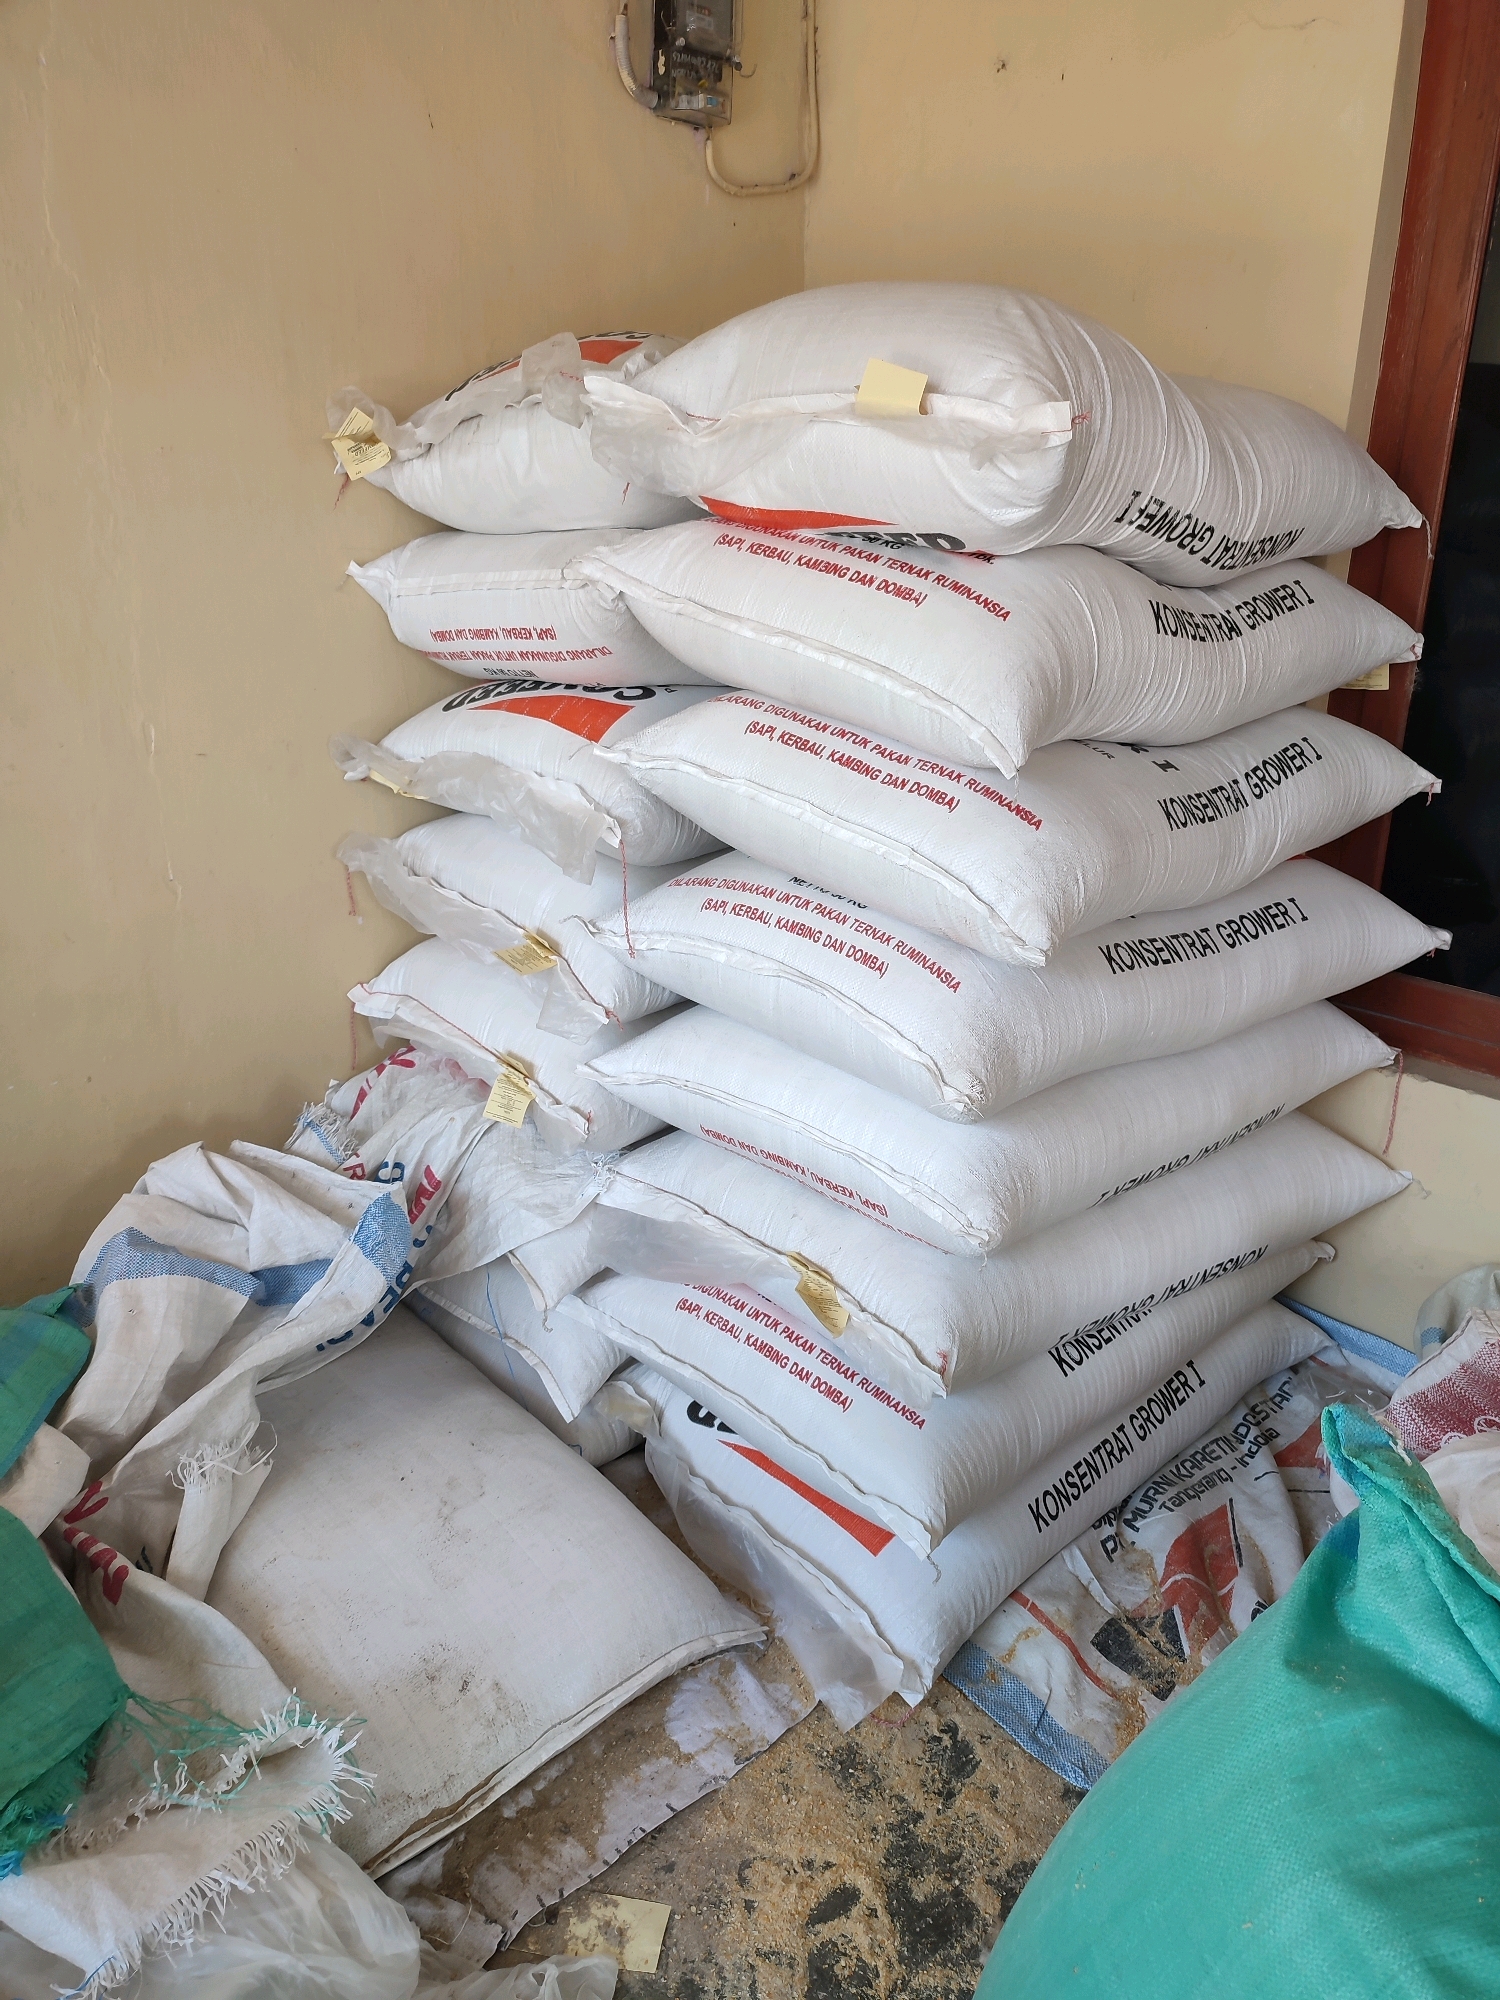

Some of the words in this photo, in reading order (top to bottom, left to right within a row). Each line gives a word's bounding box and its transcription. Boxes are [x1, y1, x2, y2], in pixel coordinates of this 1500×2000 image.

[1113, 490, 1142, 523] I
[713, 532, 747, 552] (SAPI,
[745, 541, 794, 566] KERBAU,
[793, 553, 851, 579] KAMBING
[848, 569, 878, 588] DAN
[875, 578, 929, 608] DOMBA)
[1200, 527, 1306, 571] KONSENTRAT
[799, 535, 844, 553] UNTUK
[838, 545, 885, 564] PAKAN
[882, 557, 936, 581] TERNAK
[932, 573, 1012, 622] RUMINANSIA
[454, 628, 469, 641] DAN
[468, 627, 501, 641] KAMBING
[498, 625, 534, 641] KERBAU,
[532, 624, 558, 641] (SAPI,
[1148, 599, 1244, 643] KONSENTRAT
[1235, 583, 1306, 631] GROWER
[1292, 579, 1316, 605] I
[470, 650, 496, 662] PAKAN
[493, 650, 520, 662] UNTUK
[519, 650, 568, 662] DIGUNAKAN
[566, 645, 614, 661] DILARANG
[743, 720, 777, 742] (SAPI,
[776, 730, 827, 760] KERBAU,
[826, 748, 883, 782] KAMBING
[879, 772, 911, 791] DAN
[907, 780, 961, 814] DOMBA)
[763, 704, 832, 734] DIGUNAKAN
[829, 726, 874, 751] UNTUK
[869, 743, 915, 766] PAKAN
[912, 758, 968, 785] TERNAK
[964, 778, 1044, 832] RUMINANSIA
[1157, 778, 1250, 832] KONSENTRAT
[1243, 743, 1310, 800] GROWER
[1301, 736, 1323, 761] I
[667, 876, 719, 888] DILARANG
[716, 878, 778, 900] DIGUNAKAN
[775, 890, 814, 911] UNTUK
[810, 902, 852, 926] PAKAN
[849, 917, 897, 947] TERNAK
[892, 939, 962, 994] RUMINANSIA
[700, 897, 730, 917] (SAPI,
[729, 902, 774, 929] KERBAU,
[773, 915, 824, 944] KAMBING
[822, 933, 848, 955] DAN
[844, 944, 890, 980] DOMBA)
[1098, 927, 1221, 975] KONSENTRAT
[1215, 900, 1298, 949] GROWER
[1286, 897, 1310, 923] I
[737, 1138, 759, 1156] DAN
[758, 1148, 808, 1176] KAMBING
[675, 1297, 704, 1321] (SAPI,
[703, 1308, 744, 1344] KERBAU,
[743, 1333, 791, 1370] KAMBING
[789, 1361, 812, 1385] DAN
[810, 1375, 856, 1414] DOMBA)
[745, 1305, 784, 1335] UNTUK
[779, 1324, 818, 1356] PAKAN
[816, 1347, 861, 1385] TERNAK
[856, 1376, 927, 1431] RUMINANSIA
[1027, 1423, 1136, 1534] KONSENTRAT
[1128, 1369, 1196, 1442] GROWER
[1185, 1359, 1206, 1389] I
[1122, 1474, 1179, 1533] MURNI
[1158, 1467, 1234, 1513] Tangerang
